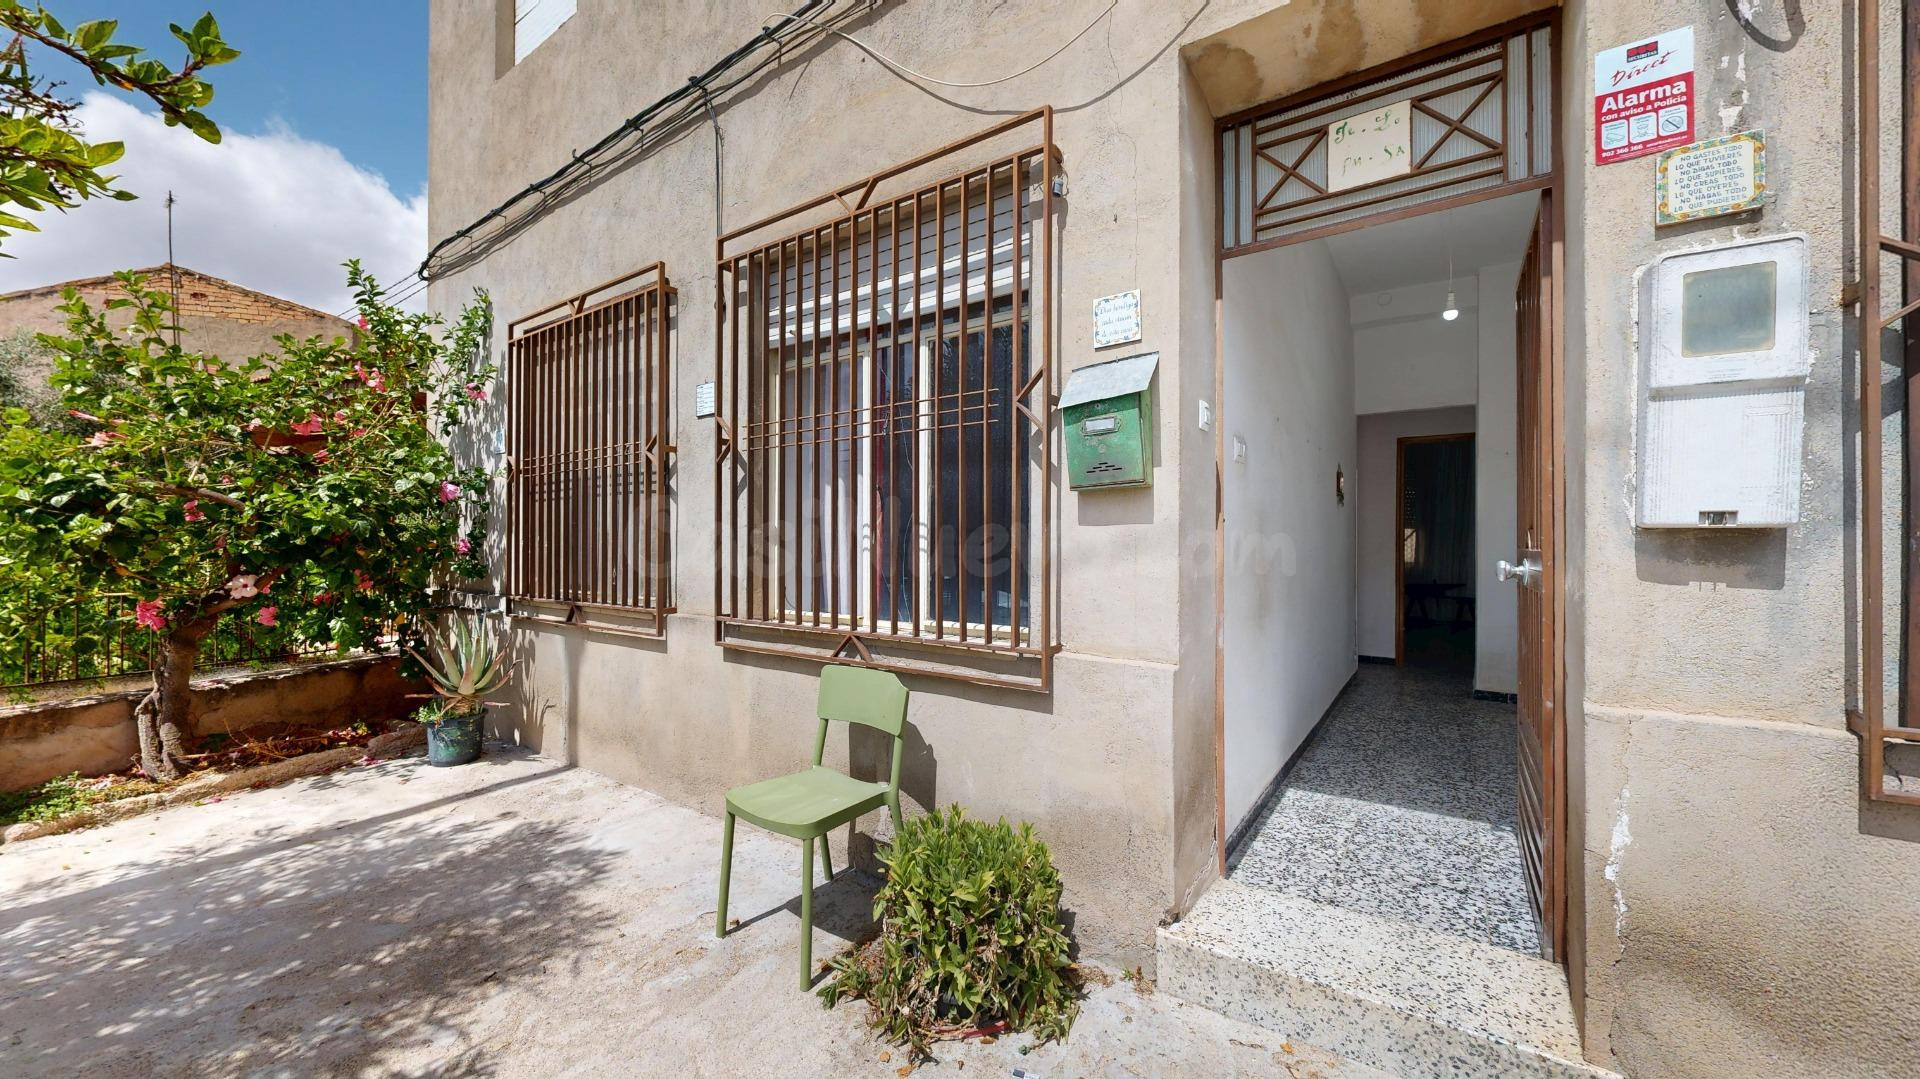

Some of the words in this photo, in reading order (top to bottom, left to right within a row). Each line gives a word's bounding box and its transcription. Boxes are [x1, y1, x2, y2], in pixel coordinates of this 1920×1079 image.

[1601, 80, 1687, 113] Alarma
[1602, 114, 1618, 122] con
[1619, 106, 1644, 118] aviso
[1693, 150, 1720, 160] GASTES
[1686, 160, 1700, 169] QUE
[1718, 159, 1738, 168] TODO
[1675, 177, 1684, 185] LO
[1688, 173, 1702, 182] QUE
[1694, 178, 1719, 188] CREAS
[1723, 172, 1745, 181] TODO
[1688, 187, 1703, 196] QUE
[1688, 201, 1703, 210] QUE
